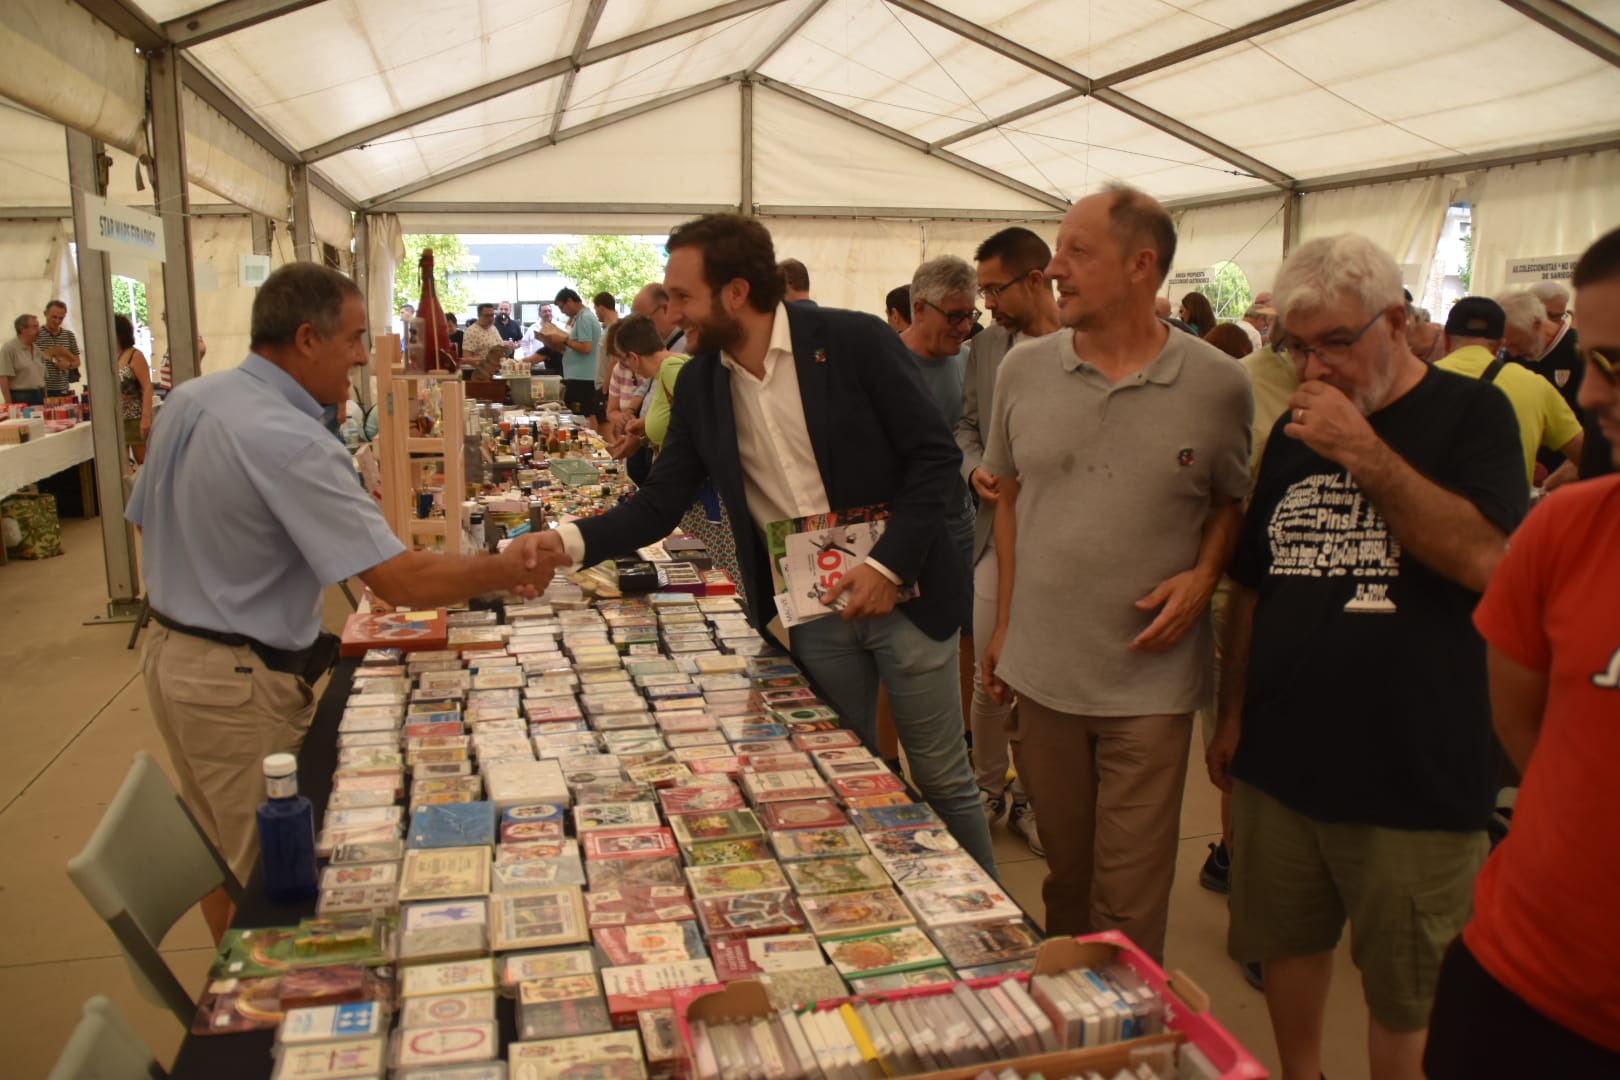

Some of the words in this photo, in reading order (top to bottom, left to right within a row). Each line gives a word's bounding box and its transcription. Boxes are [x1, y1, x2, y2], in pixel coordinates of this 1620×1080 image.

[99, 215, 114, 237] STAR
[1316, 508, 1350, 530] Pins
[1353, 567, 1399, 577] cava
